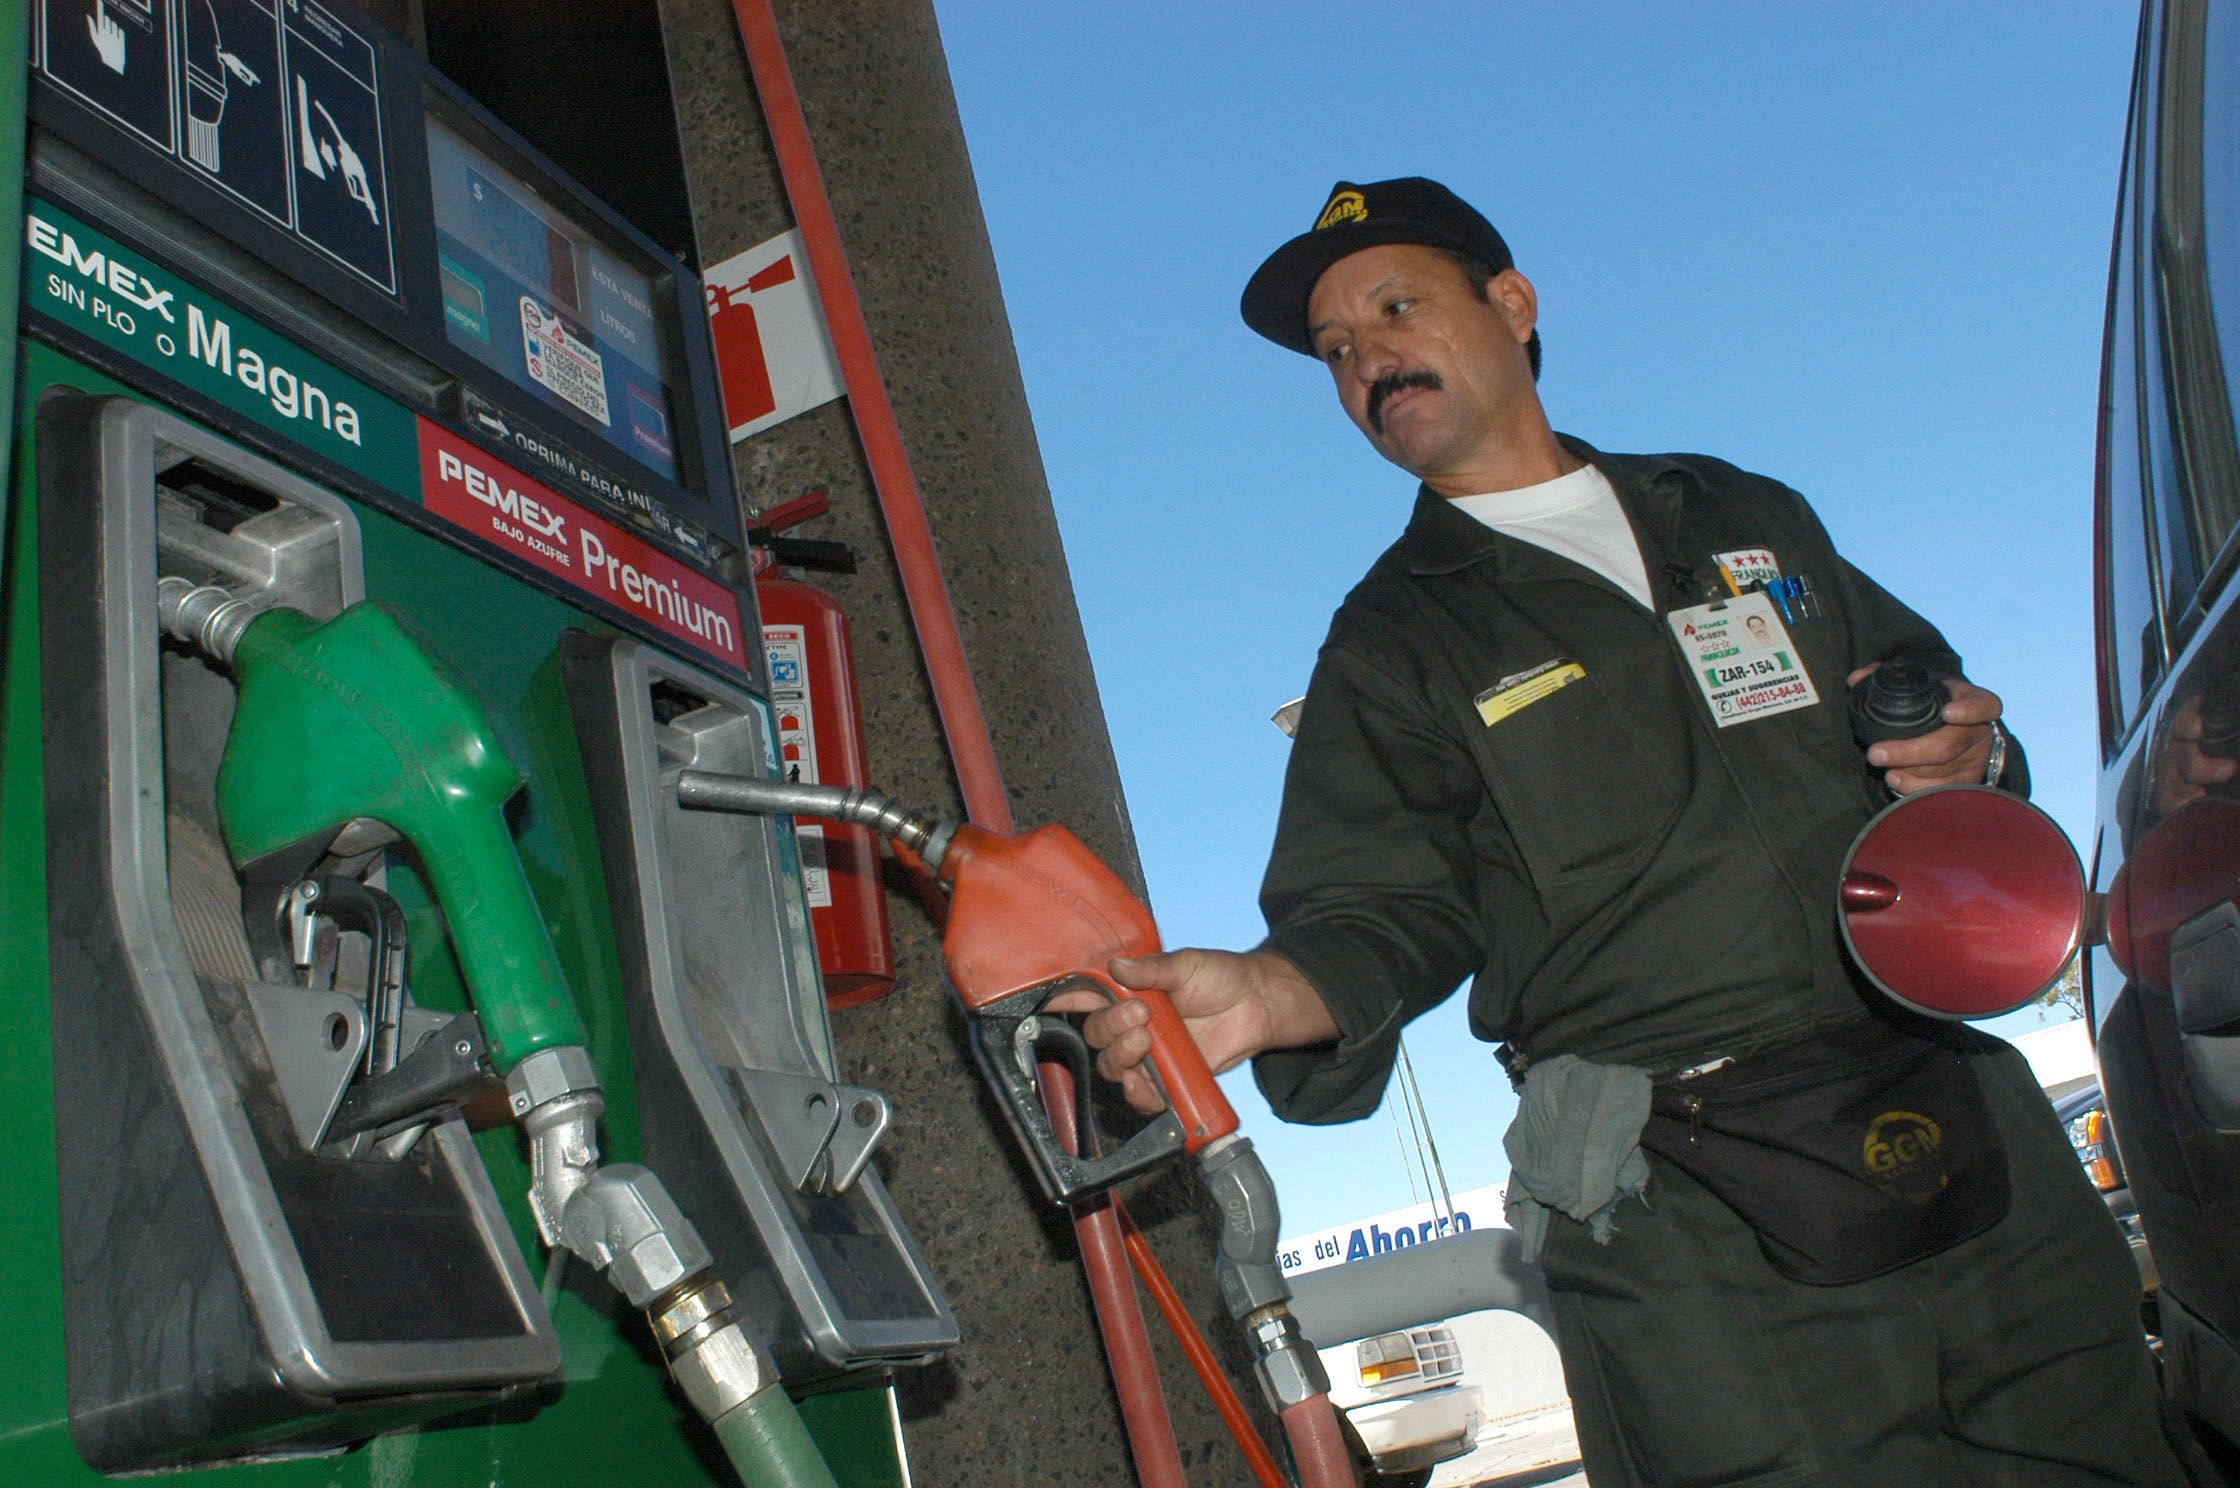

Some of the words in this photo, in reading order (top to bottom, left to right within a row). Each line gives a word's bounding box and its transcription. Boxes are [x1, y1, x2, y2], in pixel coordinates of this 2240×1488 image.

[28, 214, 174, 324] EMEX
[48, 274, 85, 310] SIN
[188, 304, 361, 446] Magna
[439, 449, 568, 546] PEMEX
[493, 516, 524, 543] BAJO
[527, 536, 570, 568] AZUFRE
[580, 528, 734, 651] Premium
[1718, 660, 1775, 683] ZAR-154
[1315, 1235, 1340, 1260] del
[1346, 1211, 1472, 1263] Ahorro
